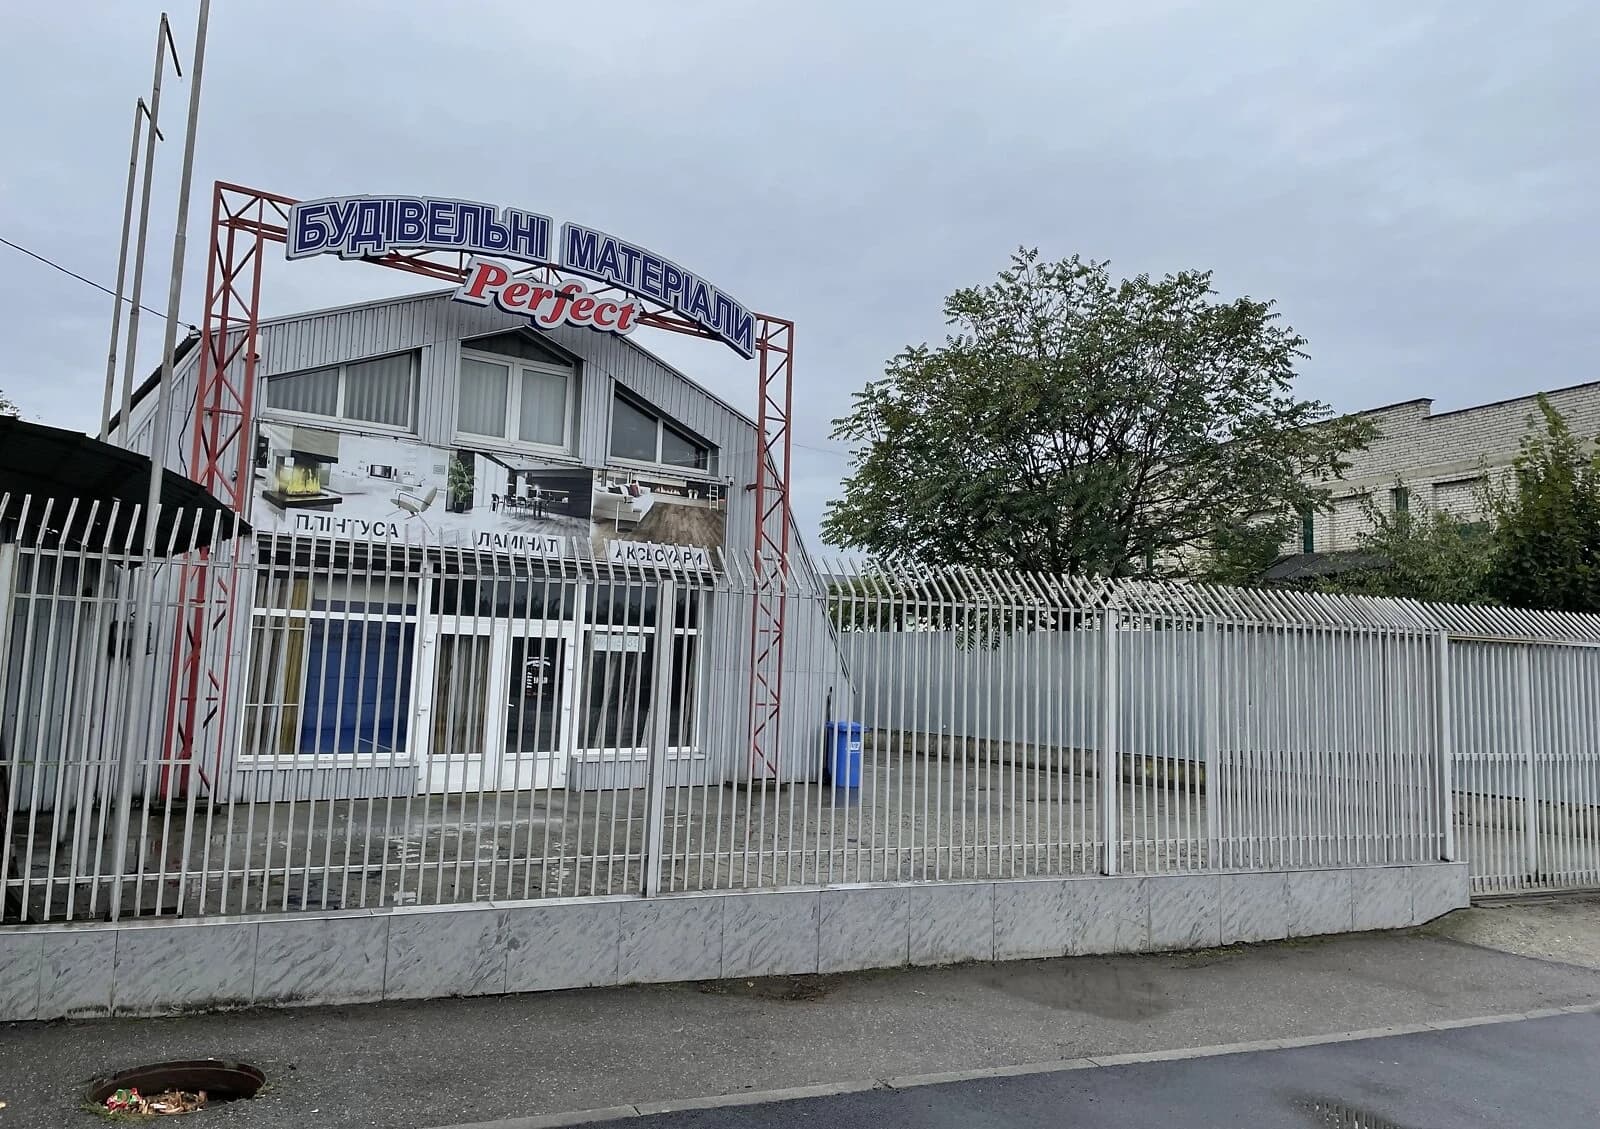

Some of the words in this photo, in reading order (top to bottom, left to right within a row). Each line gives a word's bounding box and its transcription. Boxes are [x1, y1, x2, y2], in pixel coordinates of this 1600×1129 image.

[296, 200, 550, 260] БУДІВЕЛЬНІ
[567, 226, 753, 352] МАТЕРІАЛИ
[464, 262, 636, 331] Perfect
